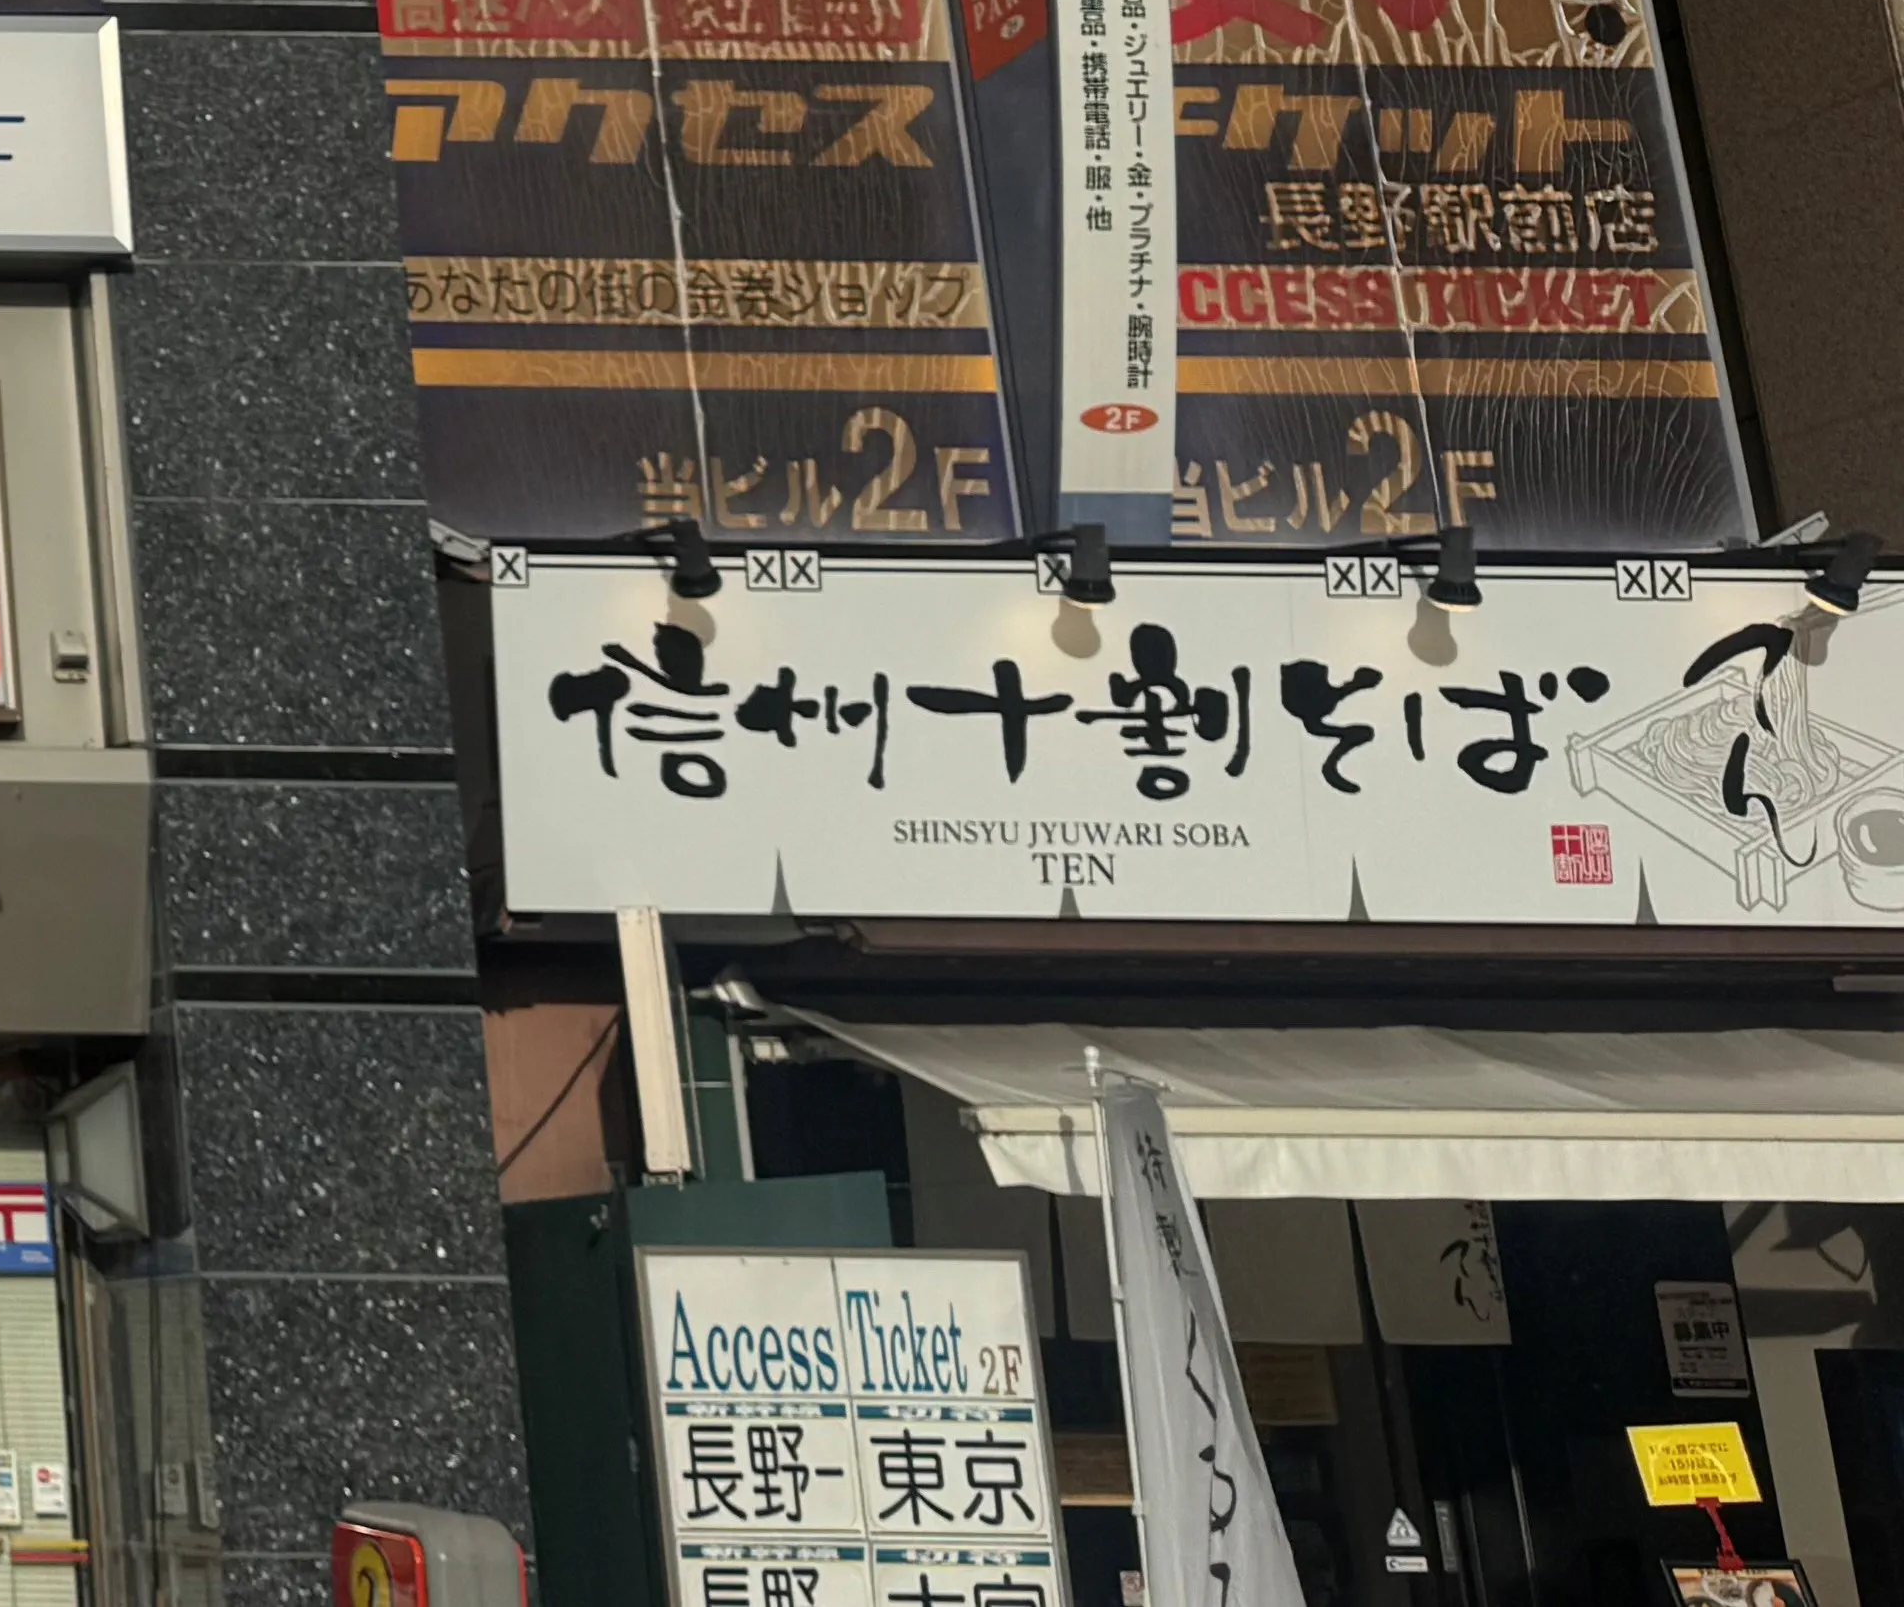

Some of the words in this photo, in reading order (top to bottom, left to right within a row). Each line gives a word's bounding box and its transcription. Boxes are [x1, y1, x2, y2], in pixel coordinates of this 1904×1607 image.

[384, 77, 936, 168] アクセス
[1258, 180, 1659, 255] 長野駅前店
[405, 266, 972, 321] あなたの街の金券ショップ
[1176, 268, 1394, 327] CCESS
[1417, 270, 1658, 329] TICKET
[1104, 405, 1142, 431] 2F
[546, 620, 1612, 801] 信州十割そば
[893, 818, 1020, 846] SHINSYU
[1028, 820, 1164, 849] JYUWARI
[1173, 823, 1251, 848] SOBA
[1032, 852, 1116, 886] TEN
[665, 1289, 841, 1394] Access
[845, 1289, 969, 1394] Ticket
[978, 1345, 1024, 1397] 2F
[870, 1428, 1037, 1526] 東京
